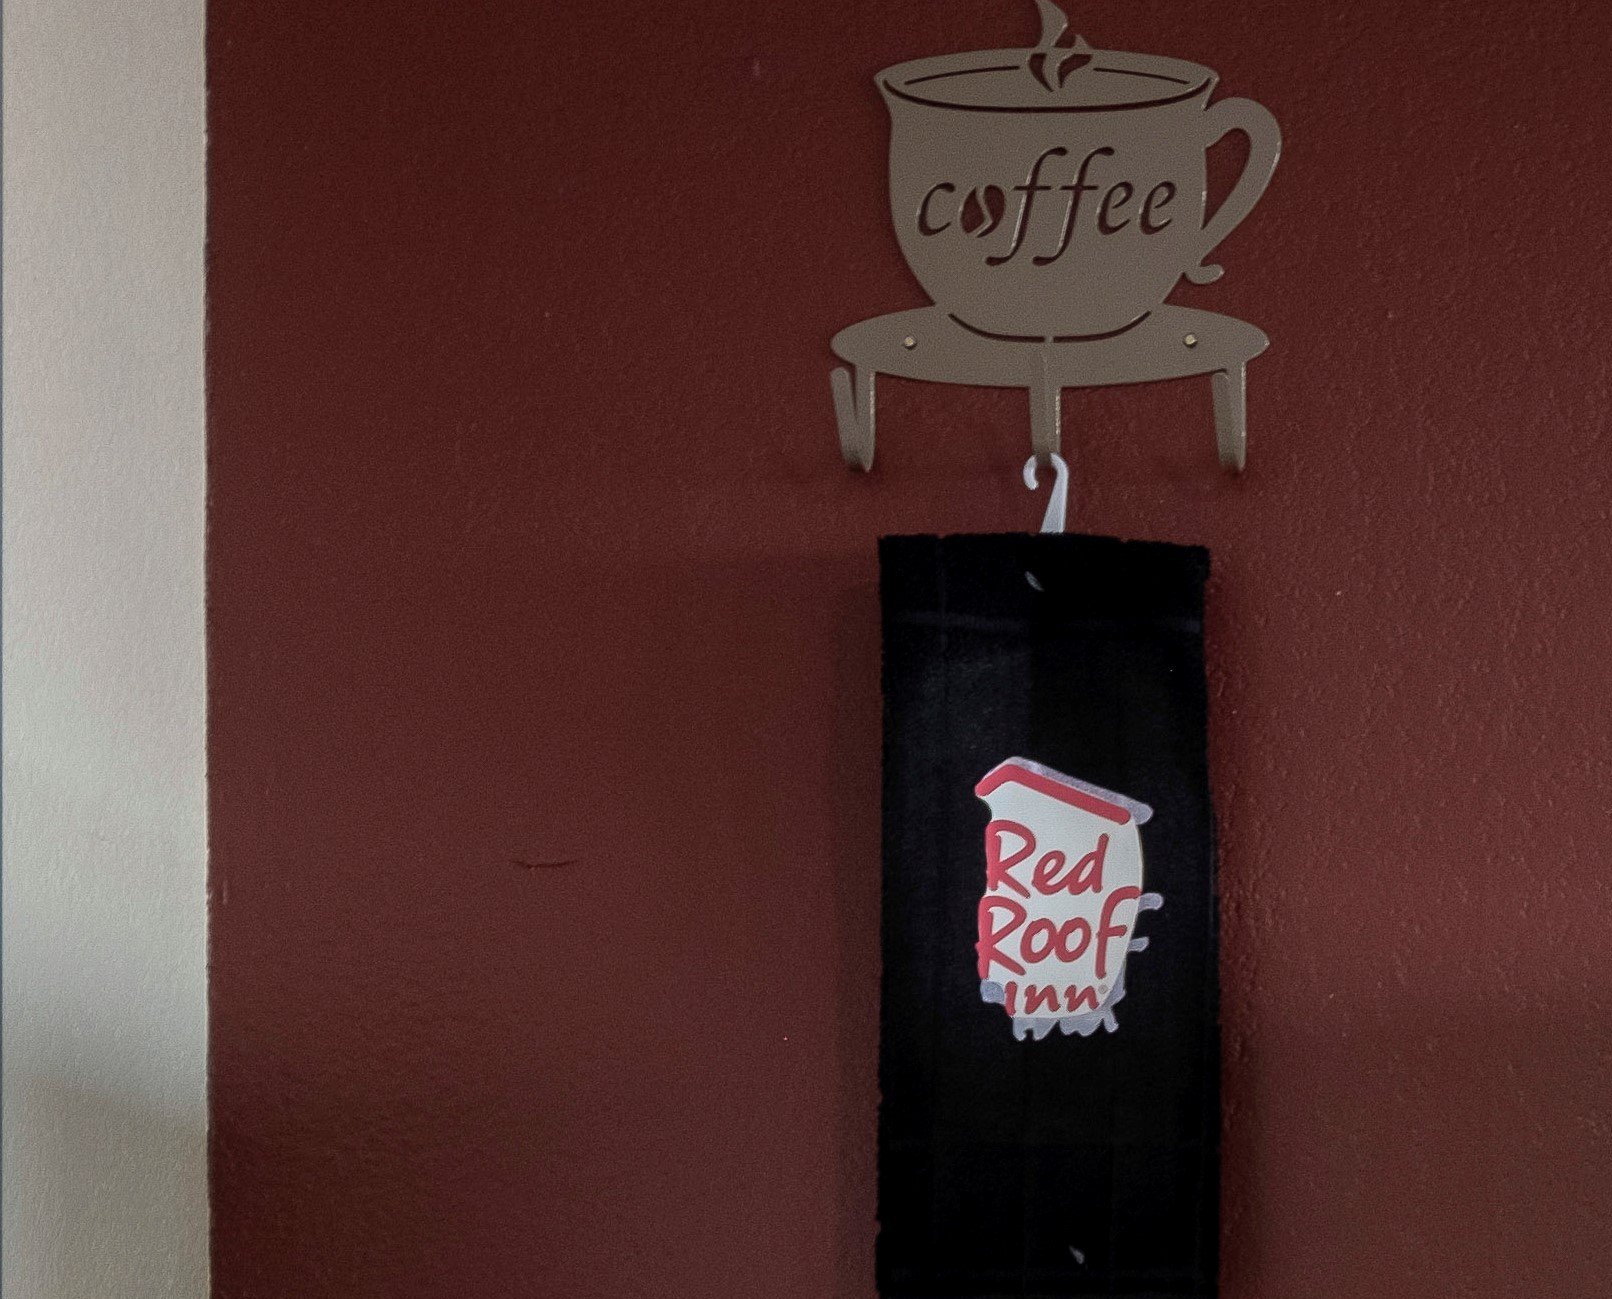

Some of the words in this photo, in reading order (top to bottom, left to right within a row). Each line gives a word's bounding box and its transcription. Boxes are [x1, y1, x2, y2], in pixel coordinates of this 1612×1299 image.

[916, 146, 1177, 267] coffee
[985, 819, 1110, 899] Red
[975, 885, 1143, 980] Roof
